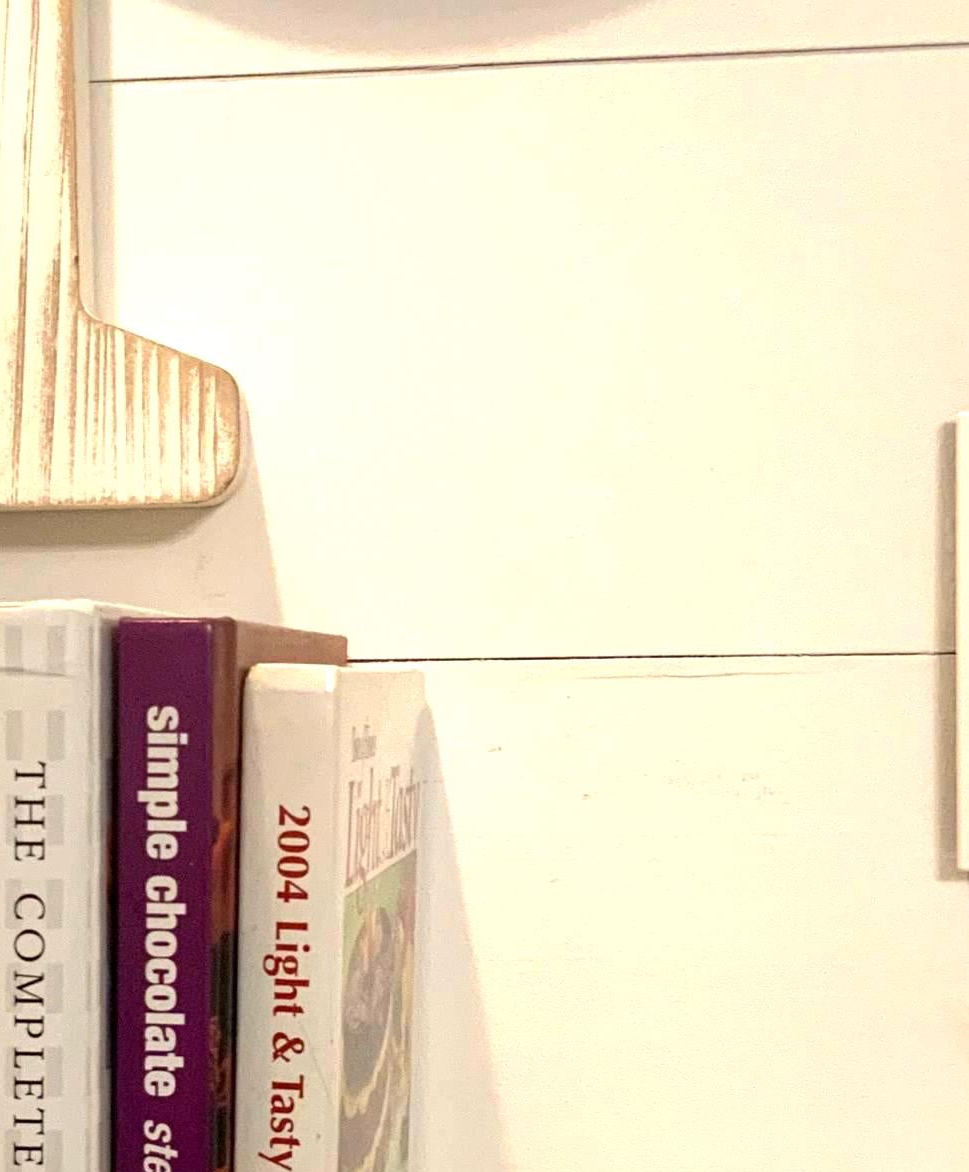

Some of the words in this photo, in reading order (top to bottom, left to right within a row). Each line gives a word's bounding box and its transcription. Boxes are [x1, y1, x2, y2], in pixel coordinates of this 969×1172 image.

[13, 760, 47, 862] THE
[136, 704, 189, 861] simple
[276, 804, 312, 904] 2004
[143, 874, 187, 1098] chocolate
[262, 920, 311, 1017] Light
[12, 892, 47, 1167] COMPLETE
[271, 1031, 305, 1064] &
[257, 1074, 305, 1172] Tasty
